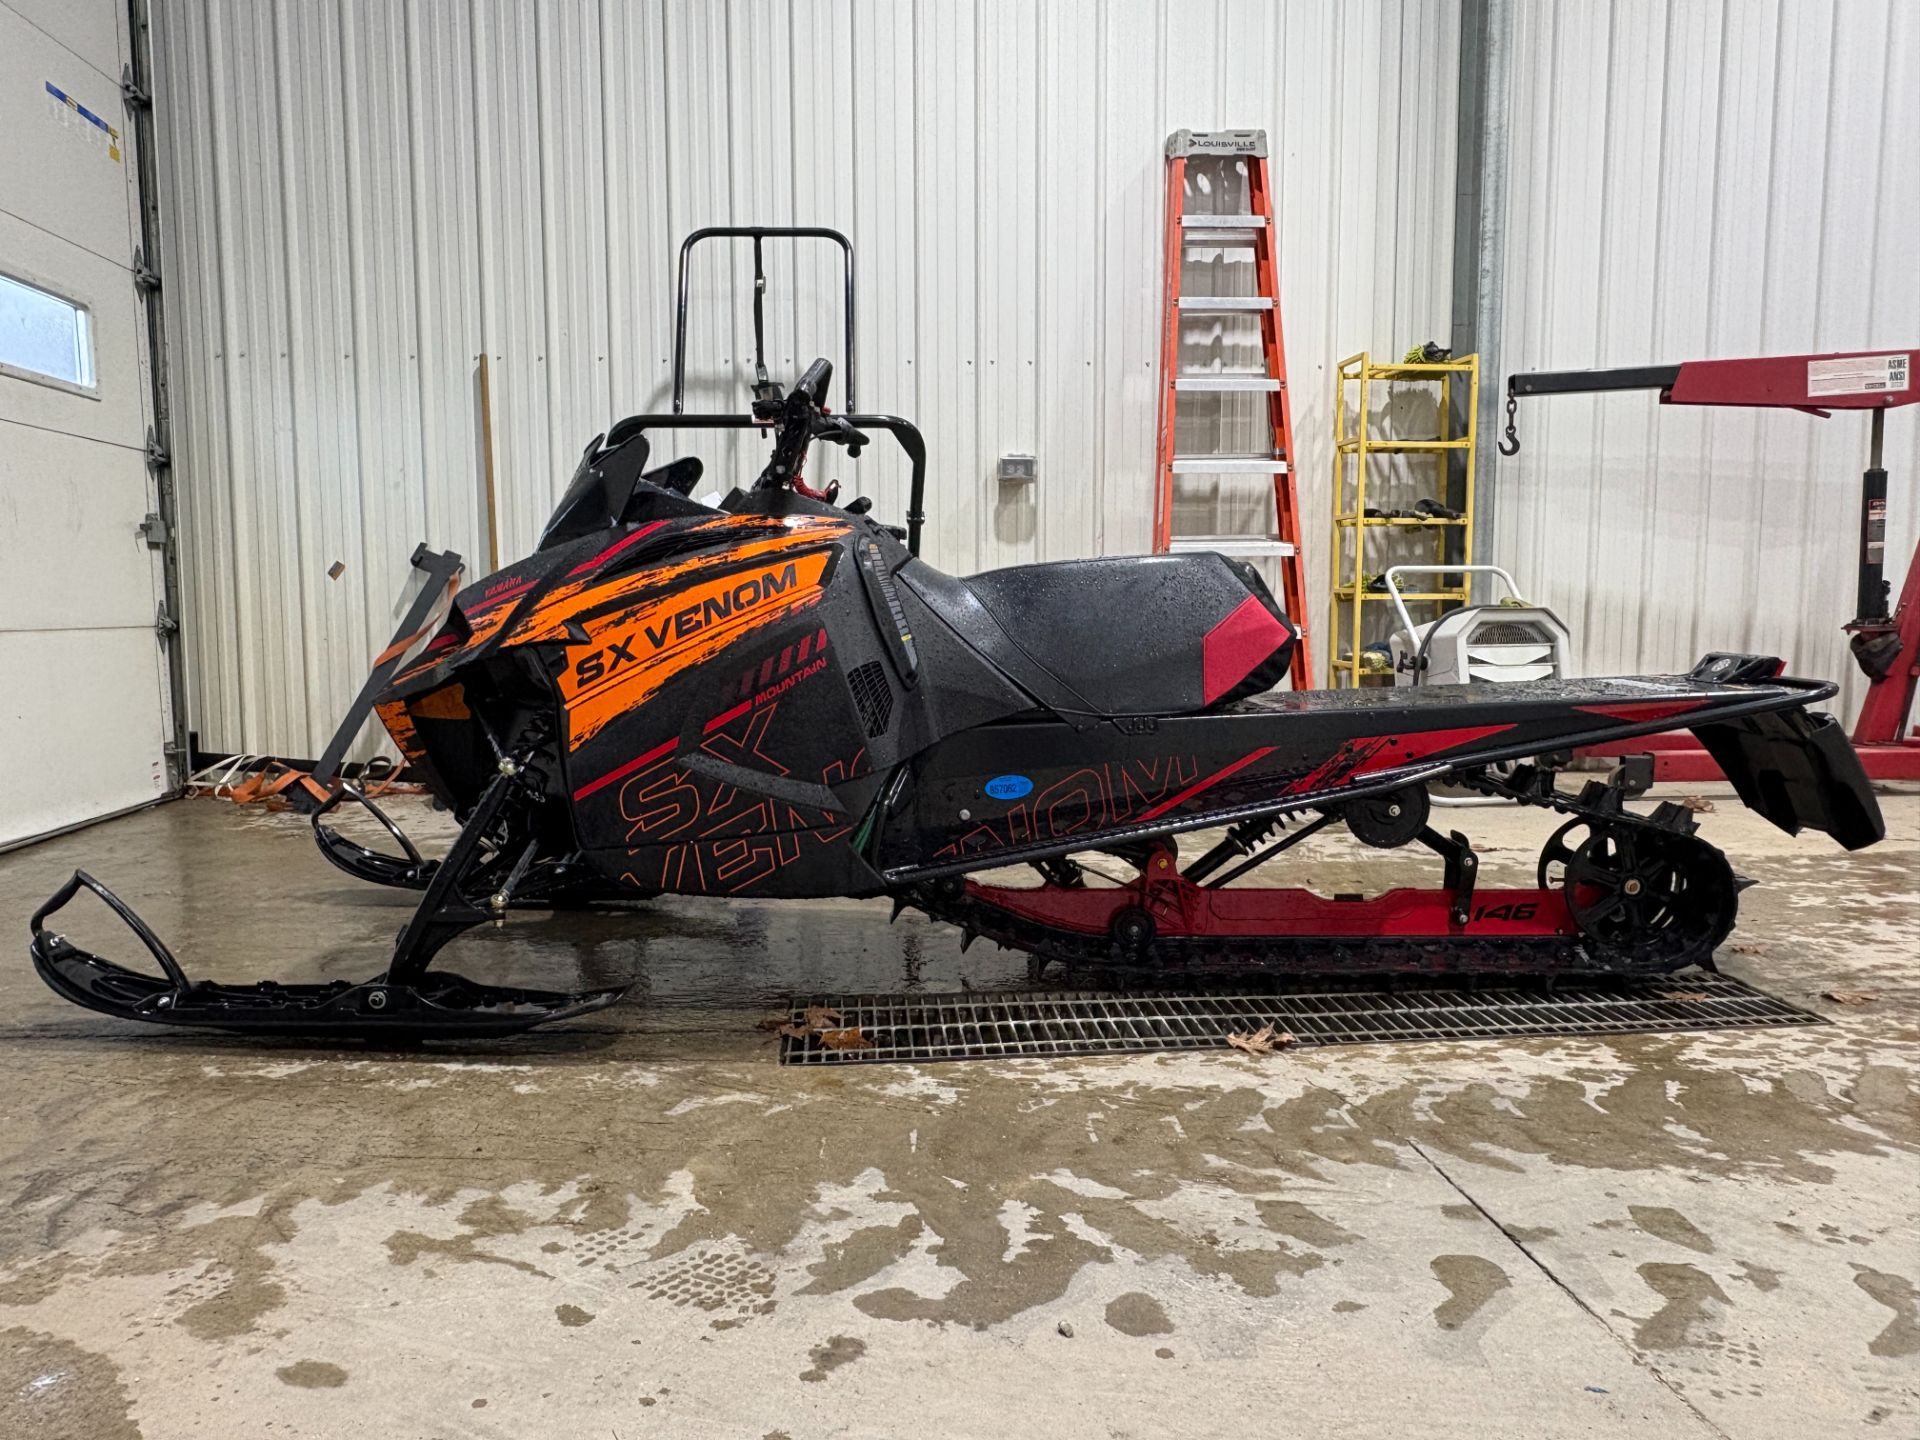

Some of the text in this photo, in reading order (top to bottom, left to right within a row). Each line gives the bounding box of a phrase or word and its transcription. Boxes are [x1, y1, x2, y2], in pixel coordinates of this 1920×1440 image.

[1888, 358, 1907, 370] ASME
[1889, 370, 1906, 382] ANSI
[576, 562, 798, 689] SX VENOM
[754, 656, 828, 705] MOUNTAIN
[1473, 902, 1539, 922] 146
